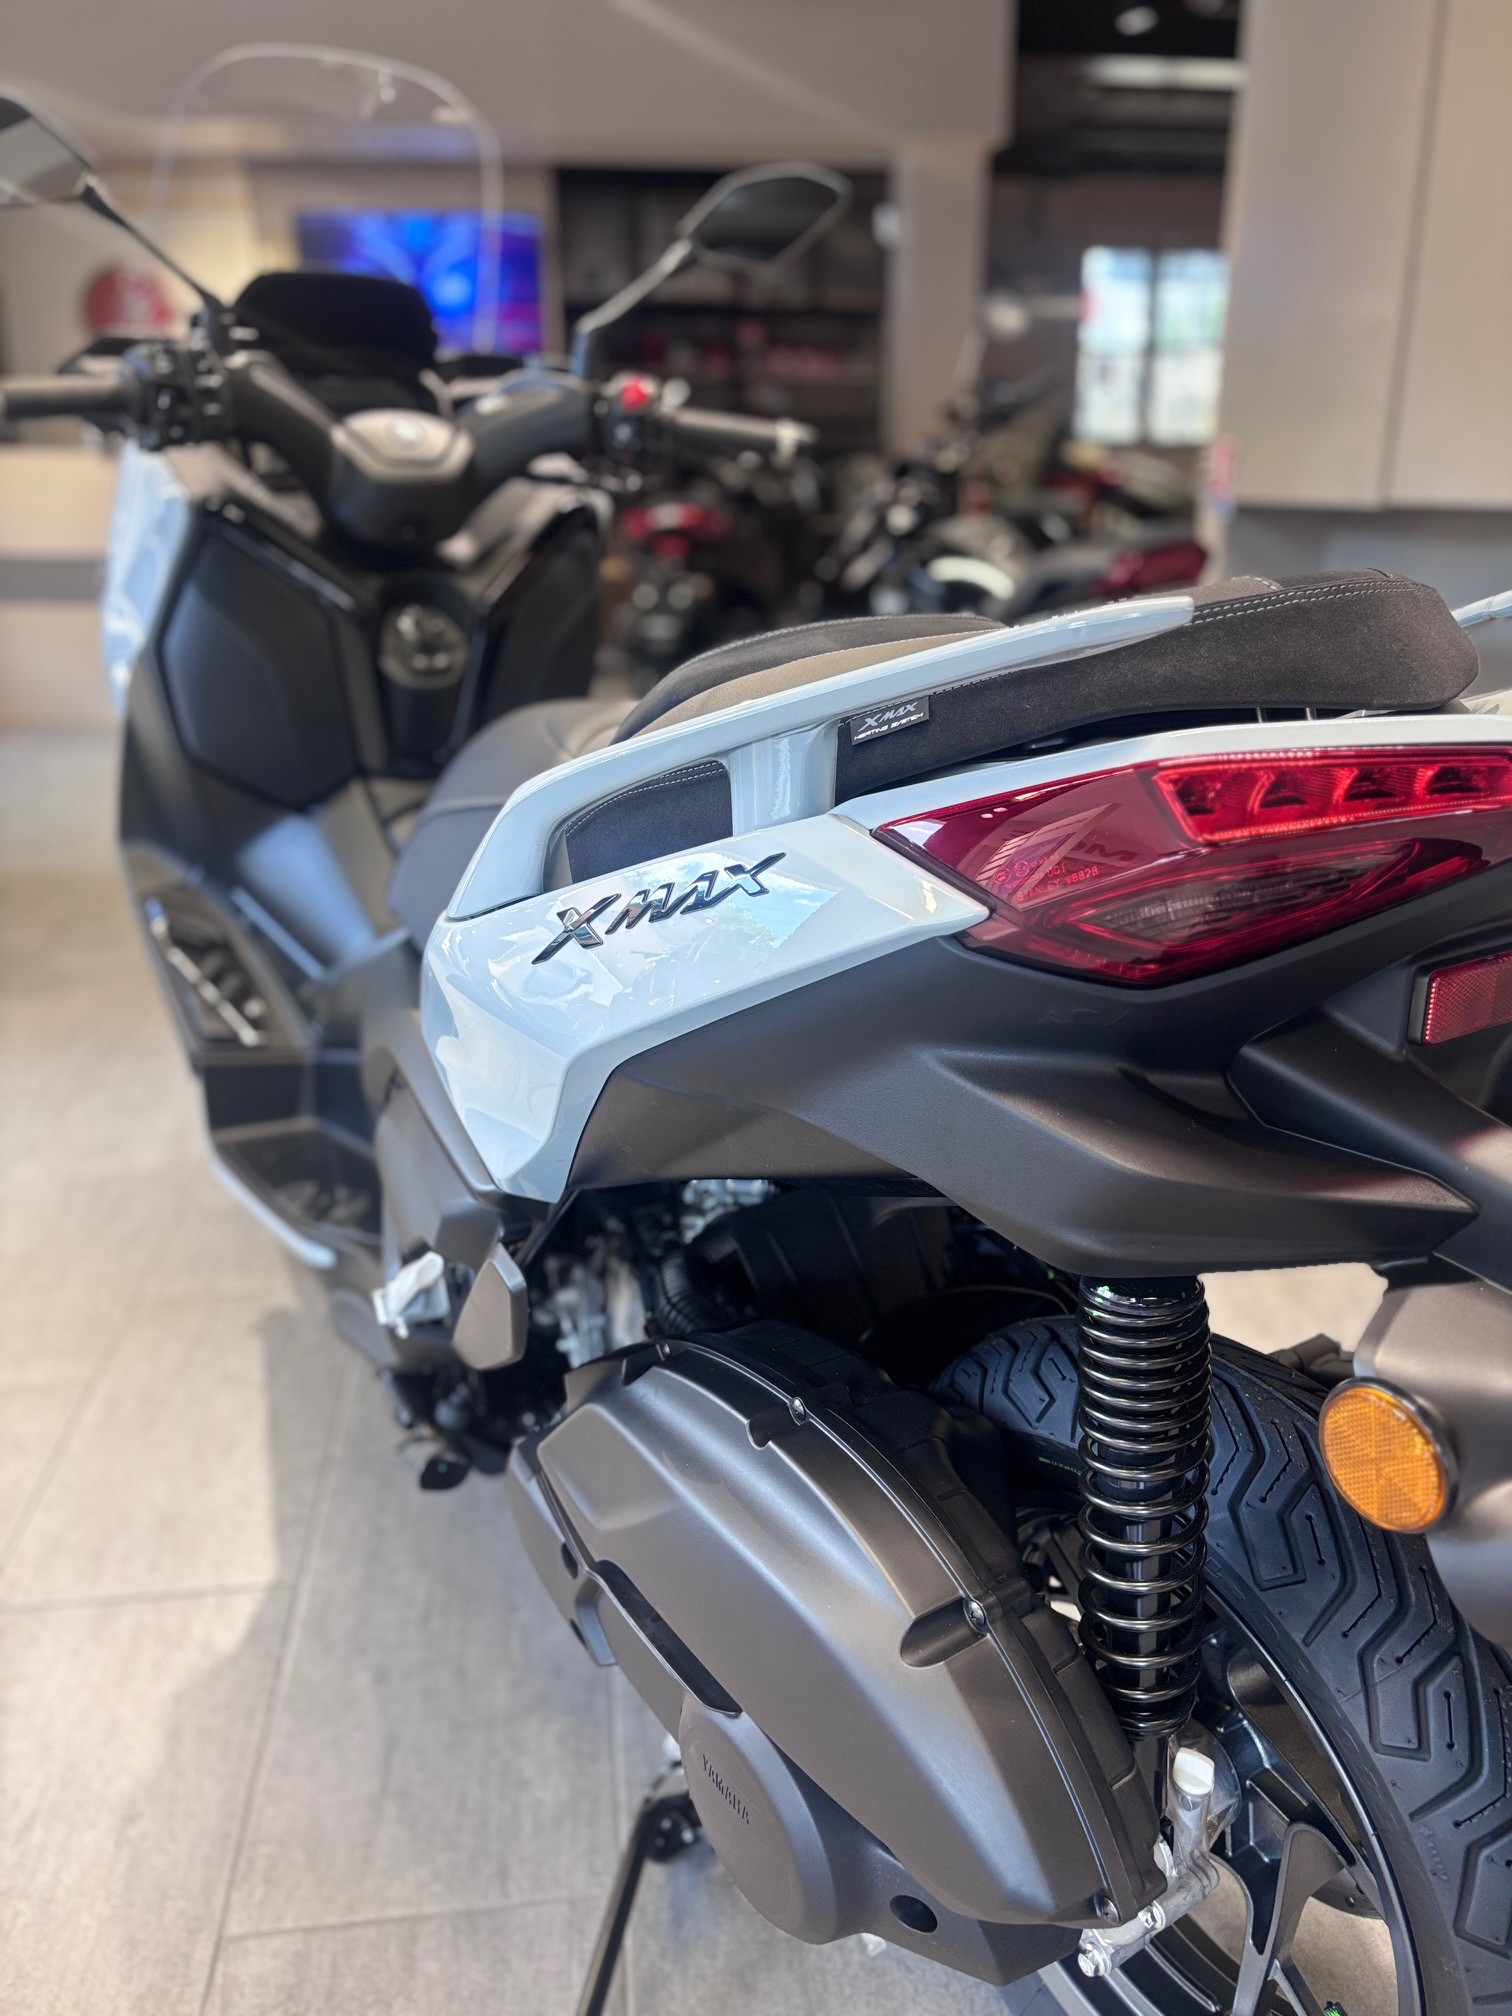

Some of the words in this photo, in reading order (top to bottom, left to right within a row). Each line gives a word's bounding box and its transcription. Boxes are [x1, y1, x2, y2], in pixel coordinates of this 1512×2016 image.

[858, 701, 918, 732] XMAX
[890, 712, 924, 728] SYSTEM
[532, 852, 786, 965] XMAX
[702, 1753, 750, 1825] YAMAHA
